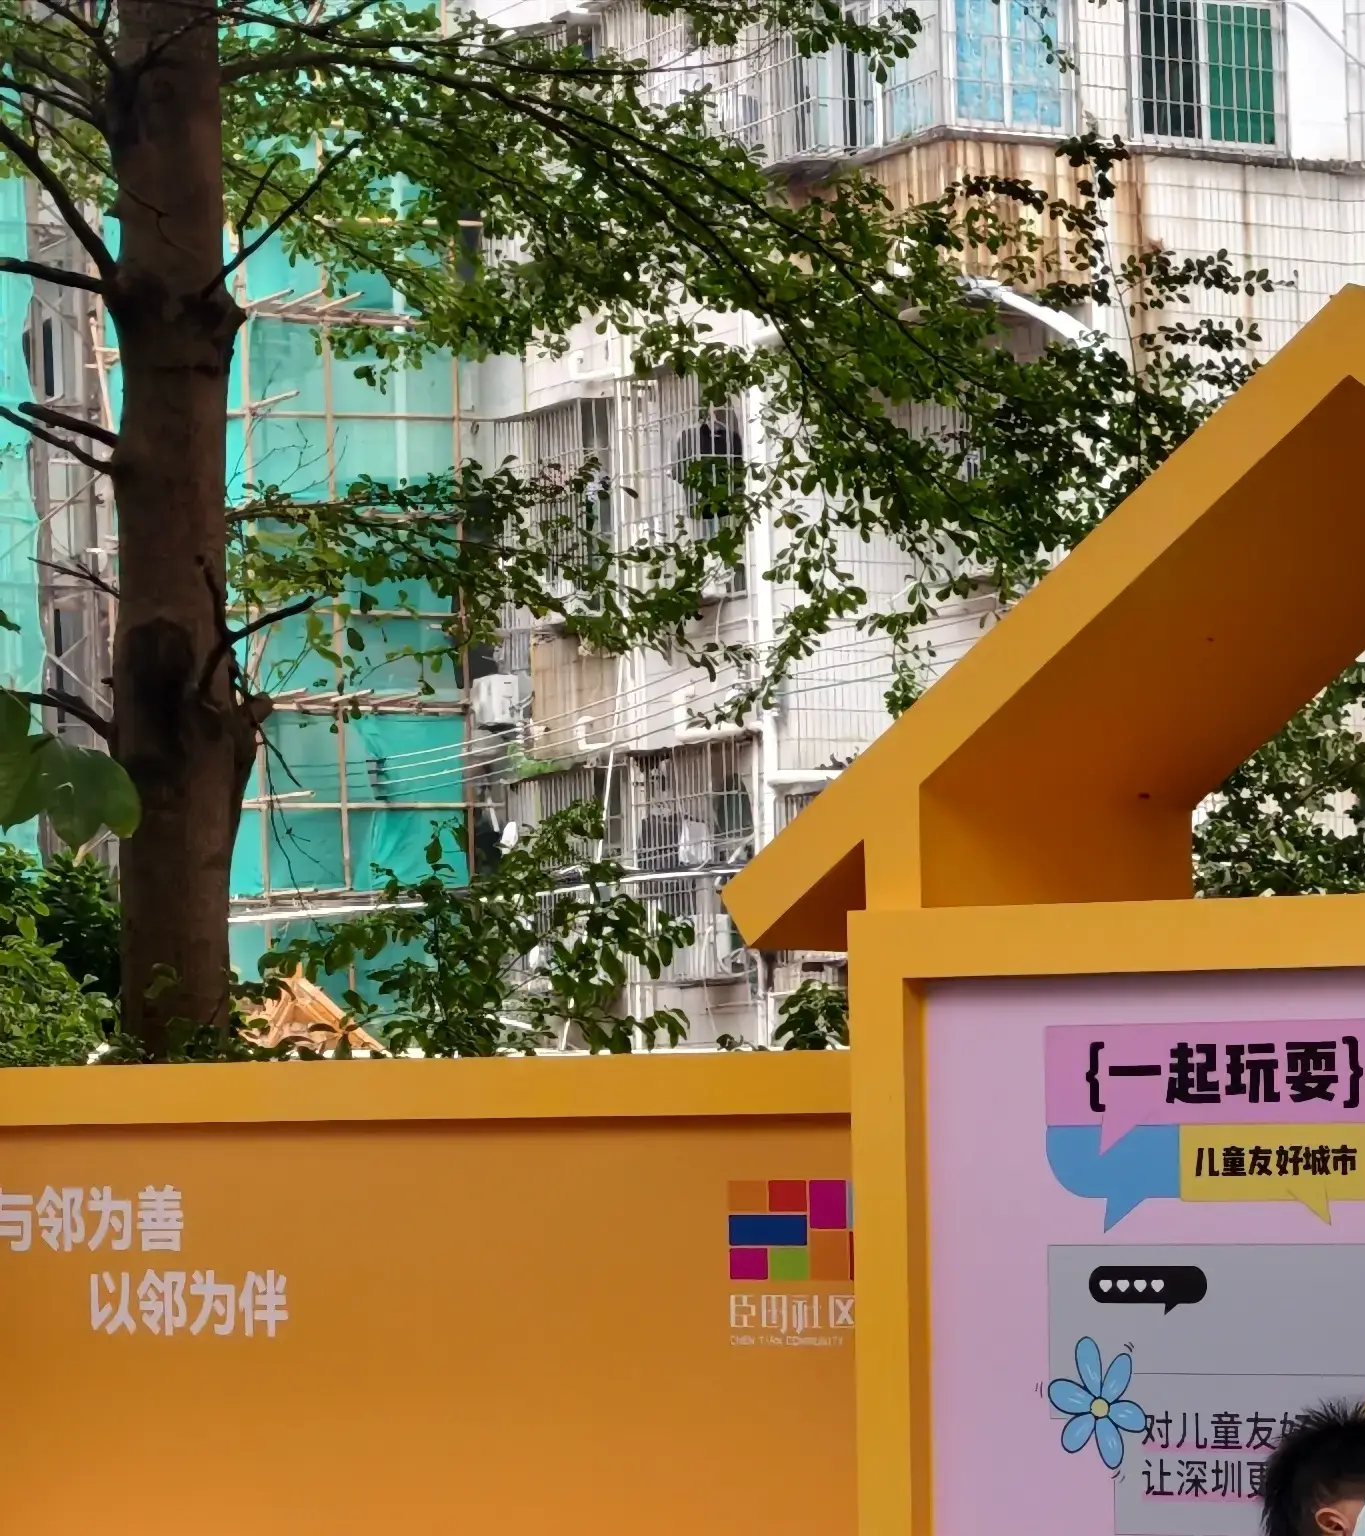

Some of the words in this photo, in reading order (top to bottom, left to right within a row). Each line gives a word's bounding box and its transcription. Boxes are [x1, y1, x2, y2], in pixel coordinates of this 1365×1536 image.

[1194, 1145, 1357, 1177] 儿童友好城市
[0, 1184, 184, 1252] 与邻为善
[90, 1268, 289, 1337] 以邻为伴
